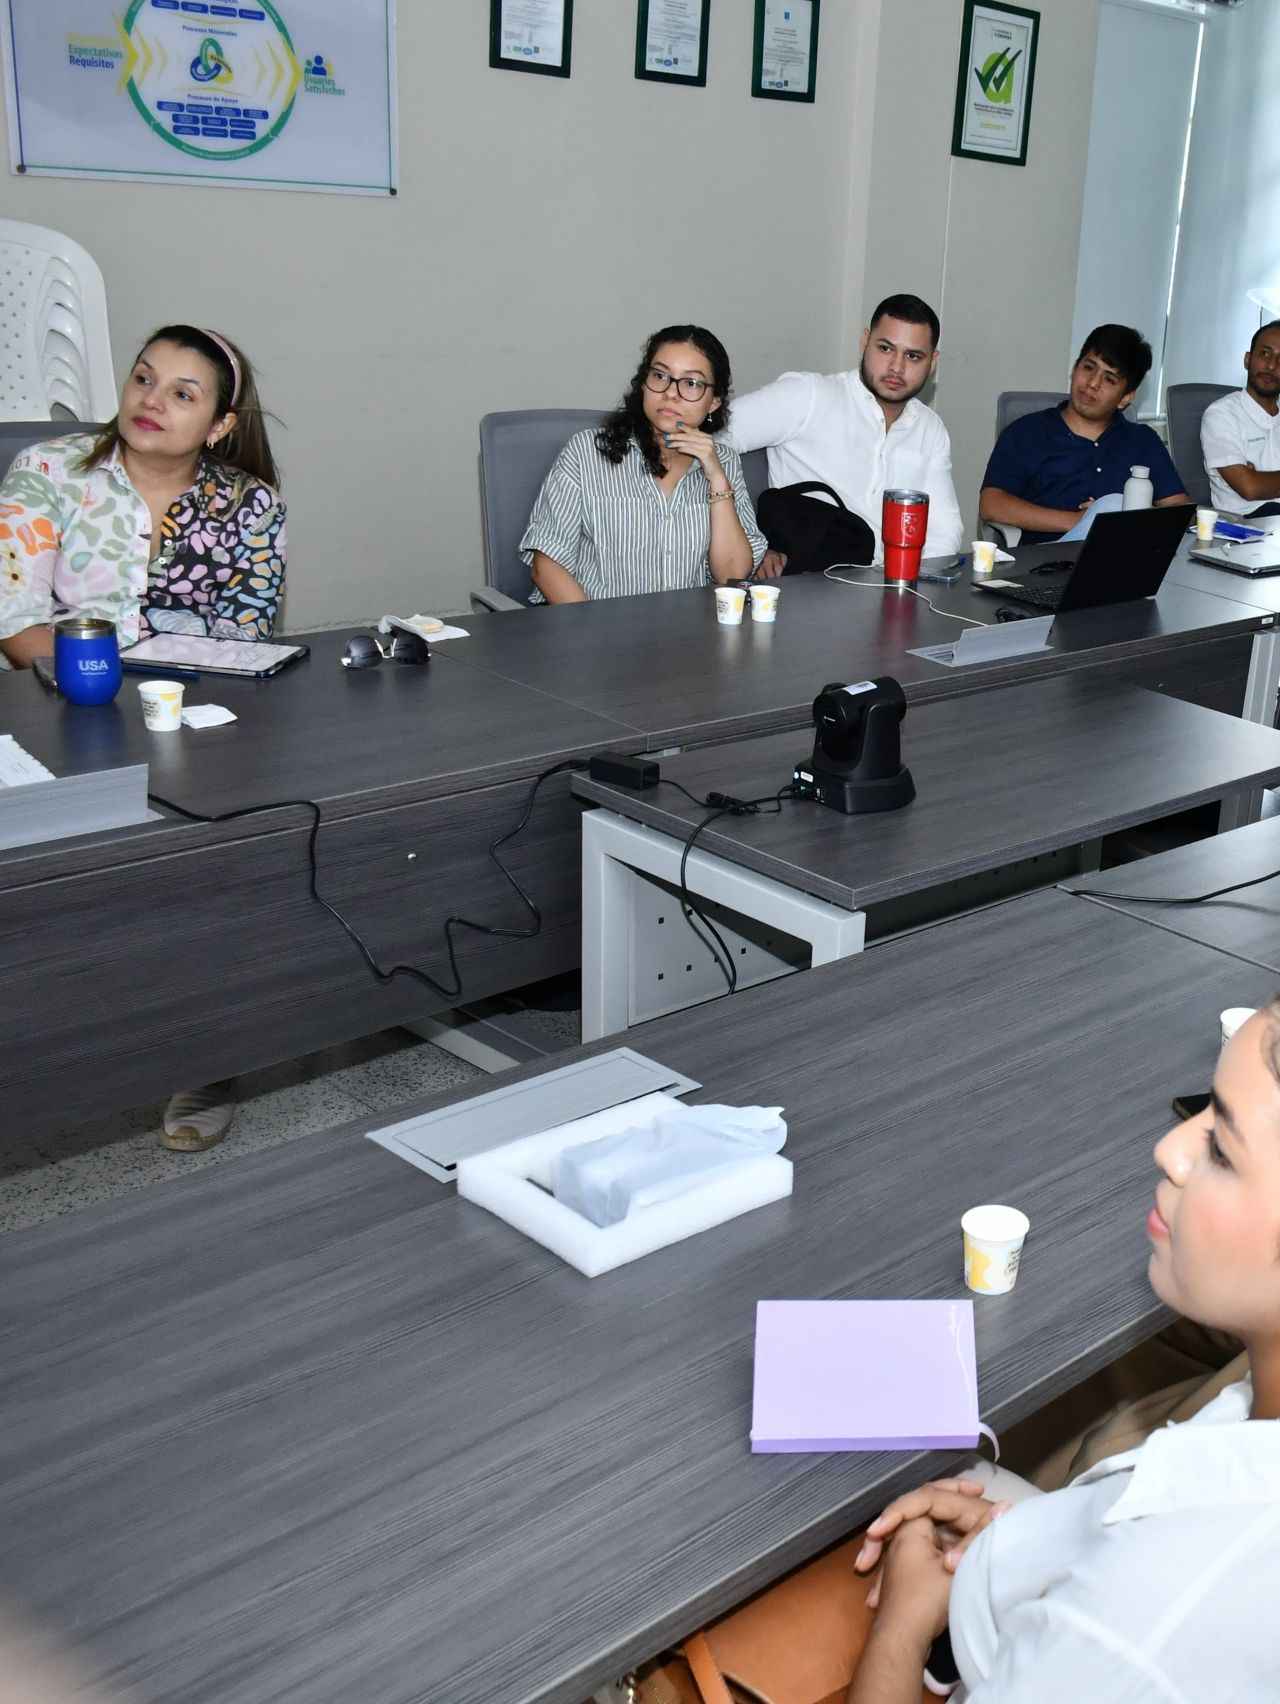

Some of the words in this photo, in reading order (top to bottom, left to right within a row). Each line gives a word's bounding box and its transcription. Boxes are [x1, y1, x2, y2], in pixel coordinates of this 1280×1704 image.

[68, 44, 123, 59] Expectativas
[69, 55, 114, 69] Requisitos
[79, 659, 109, 671] USA
